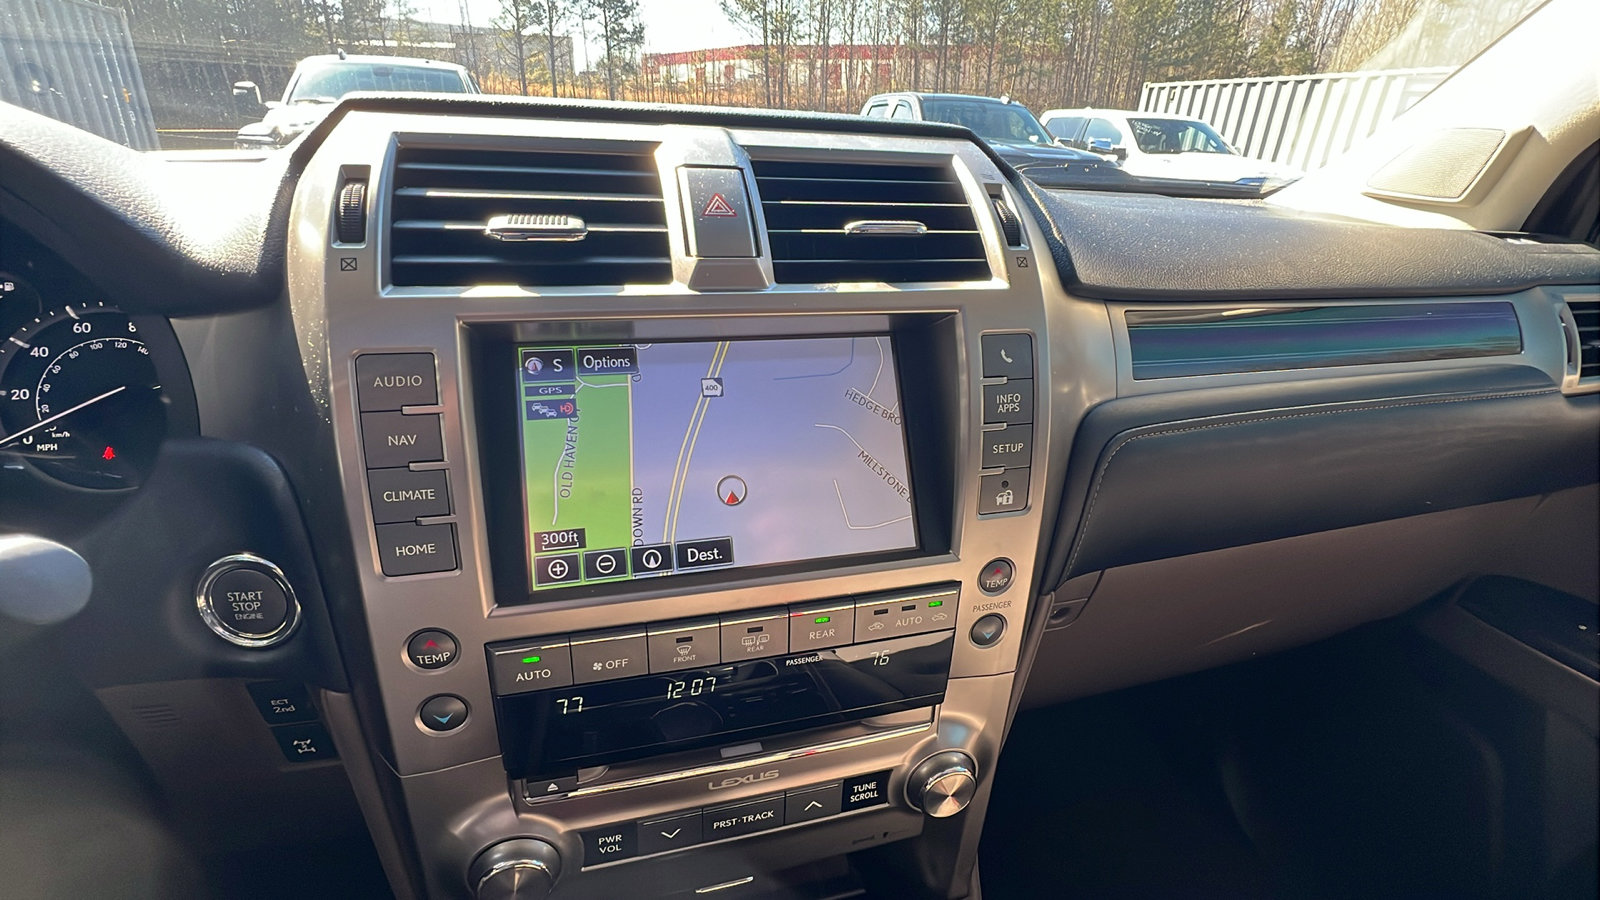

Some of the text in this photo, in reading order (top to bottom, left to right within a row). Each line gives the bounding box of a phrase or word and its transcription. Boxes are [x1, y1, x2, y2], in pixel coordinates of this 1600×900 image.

[72, 322, 92, 333] 60
[30, 347, 49, 357] 40
[90, 342, 103, 350] 100
[69, 351, 79, 359] 80
[552, 358, 563, 372] S
[583, 355, 631, 371] Options
[373, 375, 423, 388] AUDIO
[42, 383, 51, 393] 40
[538, 387, 563, 395] GPS
[705, 384, 719, 392] 400
[10, 389, 30, 400] 20
[996, 394, 1021, 404] INFO
[844, 389, 881, 415] HEDGE
[997, 403, 1020, 413] APPS
[41, 404, 50, 413] 20
[388, 434, 417, 447] NAV
[563, 425, 579, 468] HAVEN
[992, 443, 1024, 454] SETUP
[858, 450, 908, 498] MILLSTONE
[560, 471, 573, 498] OLD
[383, 489, 436, 502] CLIMATE
[632, 487, 644, 547] DOWN RD
[541, 532, 579, 544] 300ft
[396, 544, 436, 557] HOME
[687, 549, 723, 563] Dest.
[985, 578, 1008, 588] TEMP
[227, 590, 264, 602] START
[232, 601, 261, 612] STOP
[972, 600, 1012, 613] PASSENGER
[234, 612, 264, 621] ENGINE
[895, 615, 923, 628] AUTO
[809, 628, 836, 640] REAR
[746, 645, 765, 653] REAR
[416, 651, 451, 665] TEMP
[605, 658, 629, 670] OFF
[673, 654, 696, 663] FRONT
[786, 655, 823, 667] PASSENGER
[869, 650, 891, 666] 76
[515, 668, 551, 682] AUTO
[271, 698, 289, 706] ECT
[556, 696, 584, 715] 77
[273, 704, 296, 714] 2nd
[708, 769, 780, 791] LEXUS
[853, 781, 877, 793] TUNE
[850, 790, 879, 803] SCROLL
[598, 834, 622, 845] PWR
[599, 845, 622, 854] VOL
